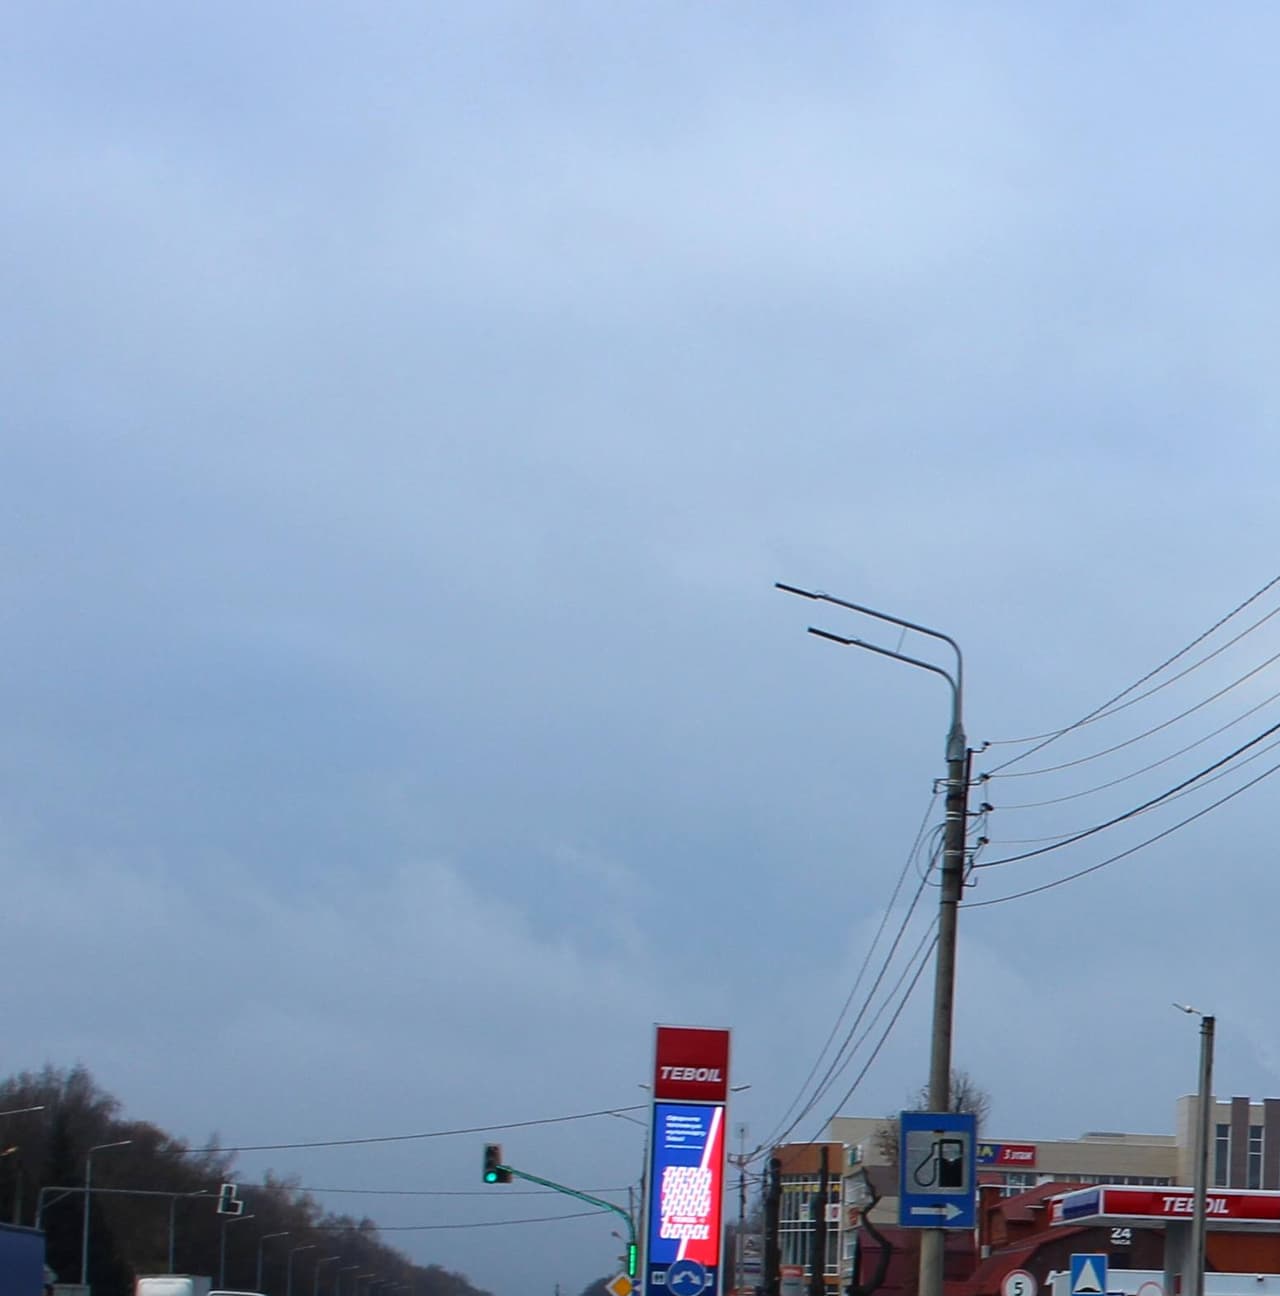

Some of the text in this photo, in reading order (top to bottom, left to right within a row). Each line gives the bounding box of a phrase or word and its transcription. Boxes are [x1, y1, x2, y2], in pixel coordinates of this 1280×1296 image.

[661, 1066, 722, 1082] TEBOIL
[1111, 1228, 1131, 1238] 24
[1014, 1282, 1023, 1296] 5
